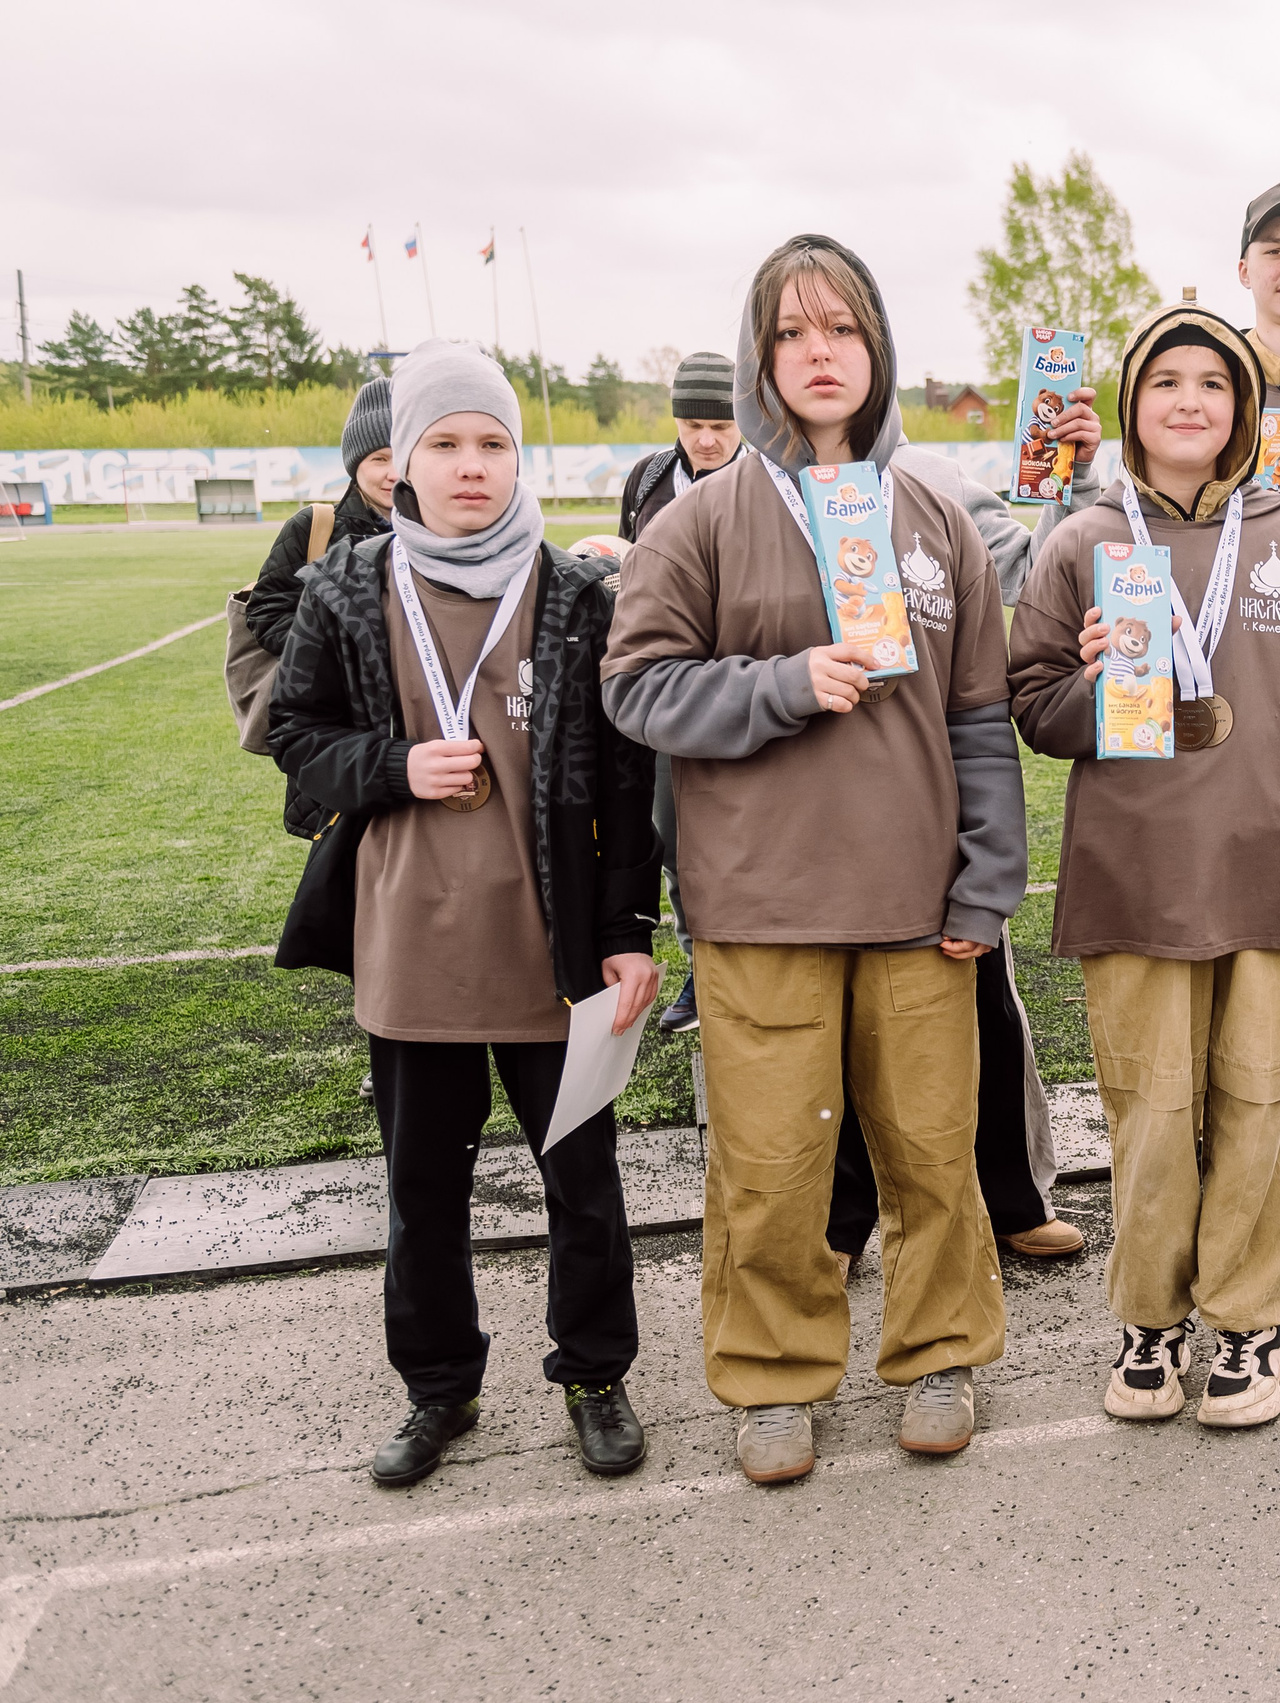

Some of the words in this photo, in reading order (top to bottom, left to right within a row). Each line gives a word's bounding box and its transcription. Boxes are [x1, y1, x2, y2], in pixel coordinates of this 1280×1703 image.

[1035, 356, 1076, 374] Барни
[826, 496, 877, 517] Барни
[1112, 577, 1163, 597] Барни
